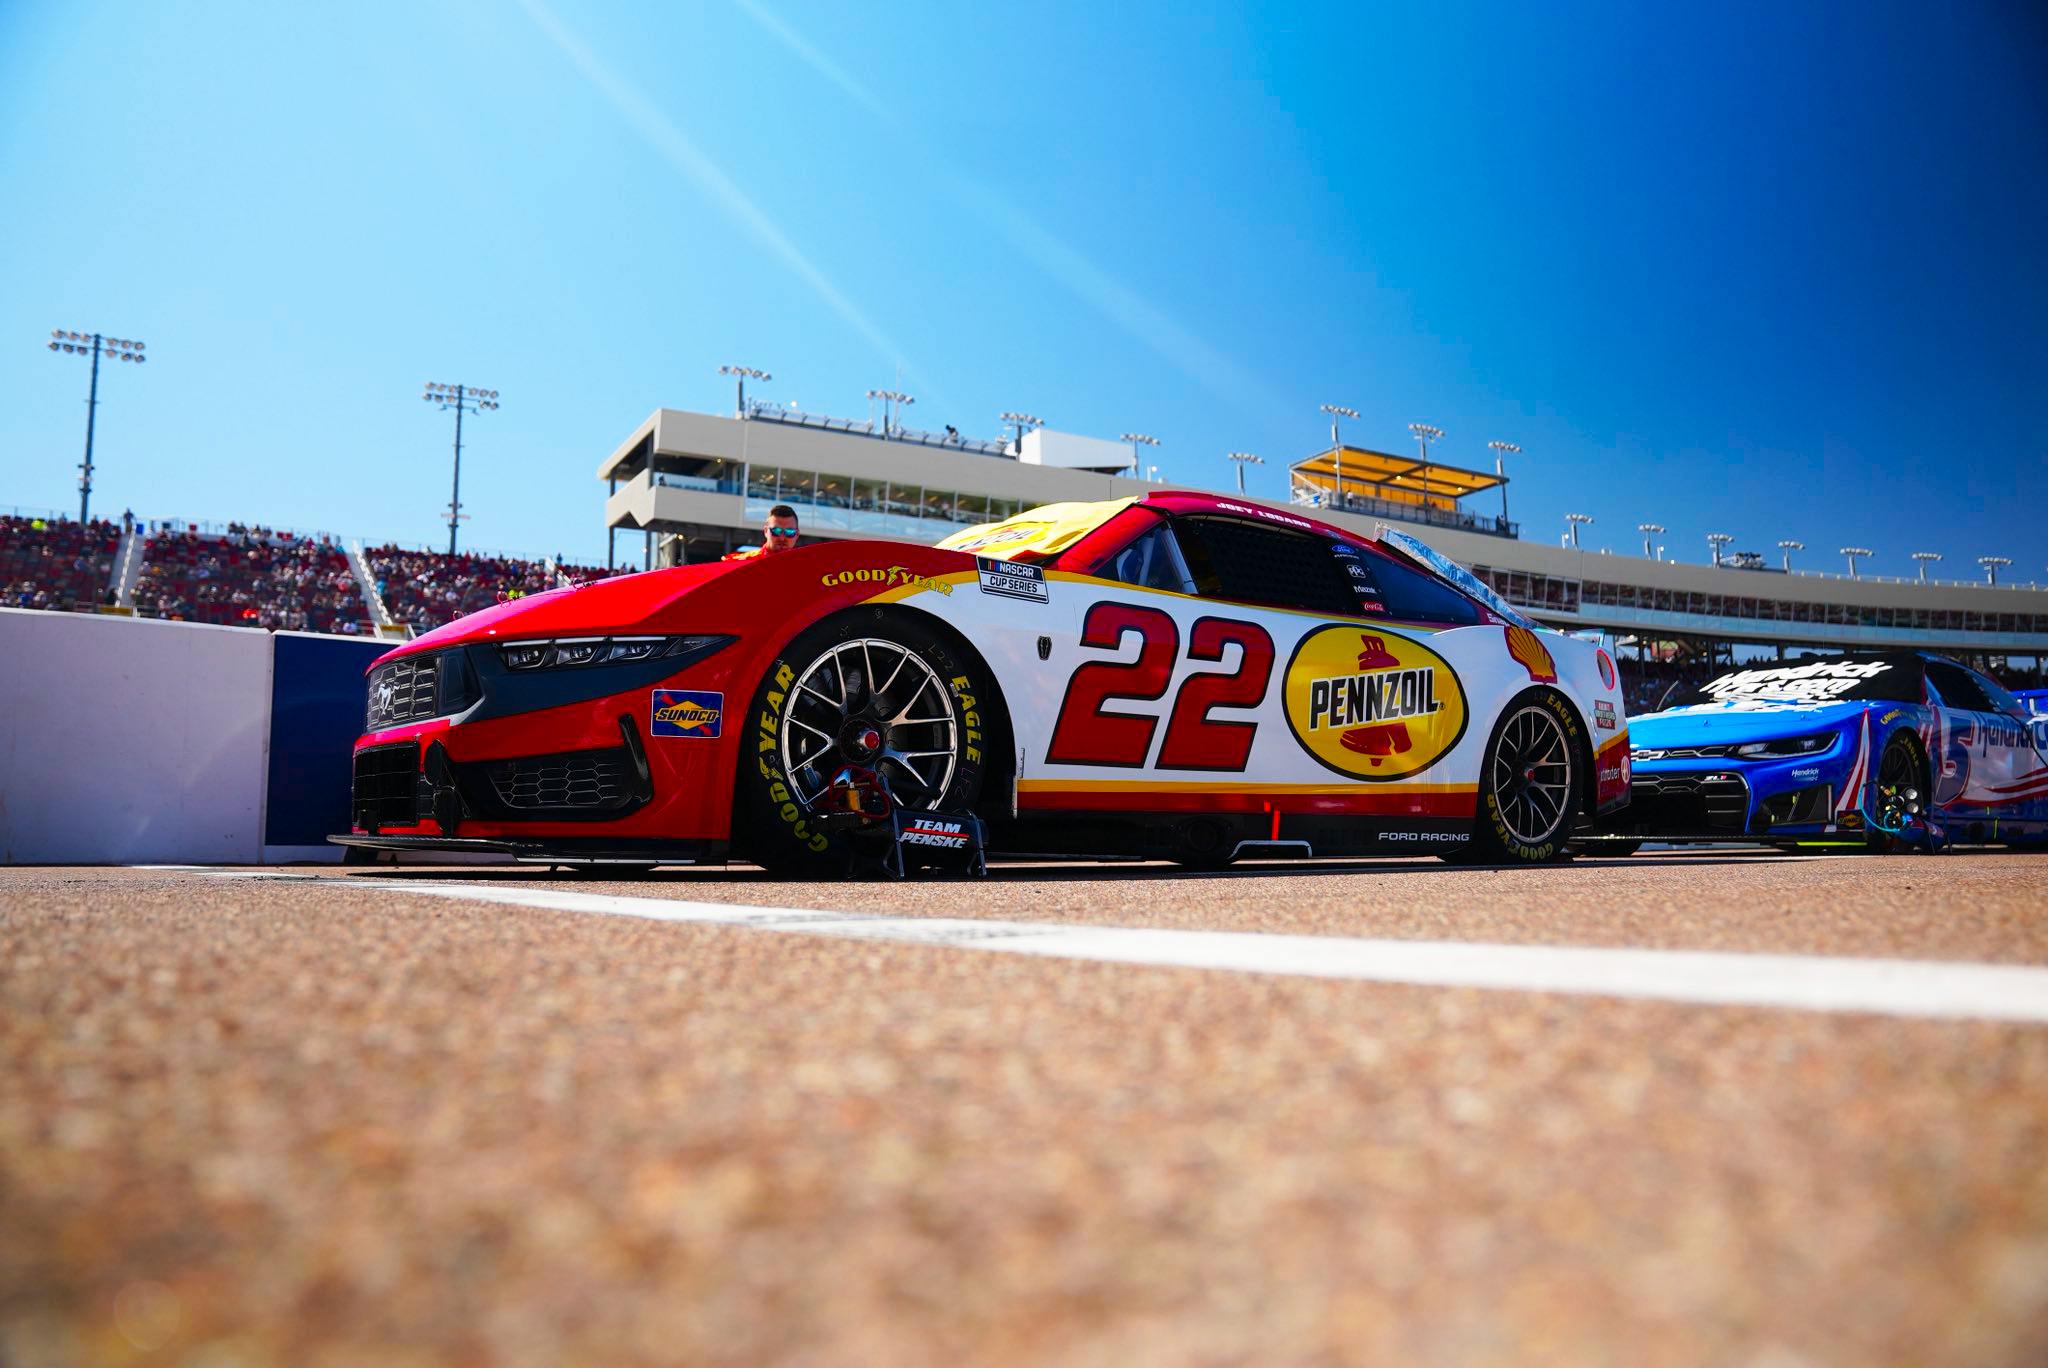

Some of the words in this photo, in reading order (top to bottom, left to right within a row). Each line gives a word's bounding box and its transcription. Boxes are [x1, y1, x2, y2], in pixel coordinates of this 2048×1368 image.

[1216, 503, 1253, 514] JOEY
[1000, 562, 1034, 578] NASCAR
[821, 565, 953, 597] GOODYEAR
[989, 575, 1008, 588] CUP
[1008, 578, 1038, 594] SERIES
[1044, 600, 1275, 773] 22
[1309, 666, 1440, 733] PENNZOIL
[657, 708, 719, 723] SUNOCO
[952, 675, 982, 764] EAGLE
[1547, 693, 1577, 737] EAGLE
[758, 664, 829, 852] GOODYEAR
[914, 819, 962, 834] TEAM
[899, 831, 968, 848] PENSKE
[1378, 831, 1418, 842] FORD
[1420, 832, 1470, 843] RACING
